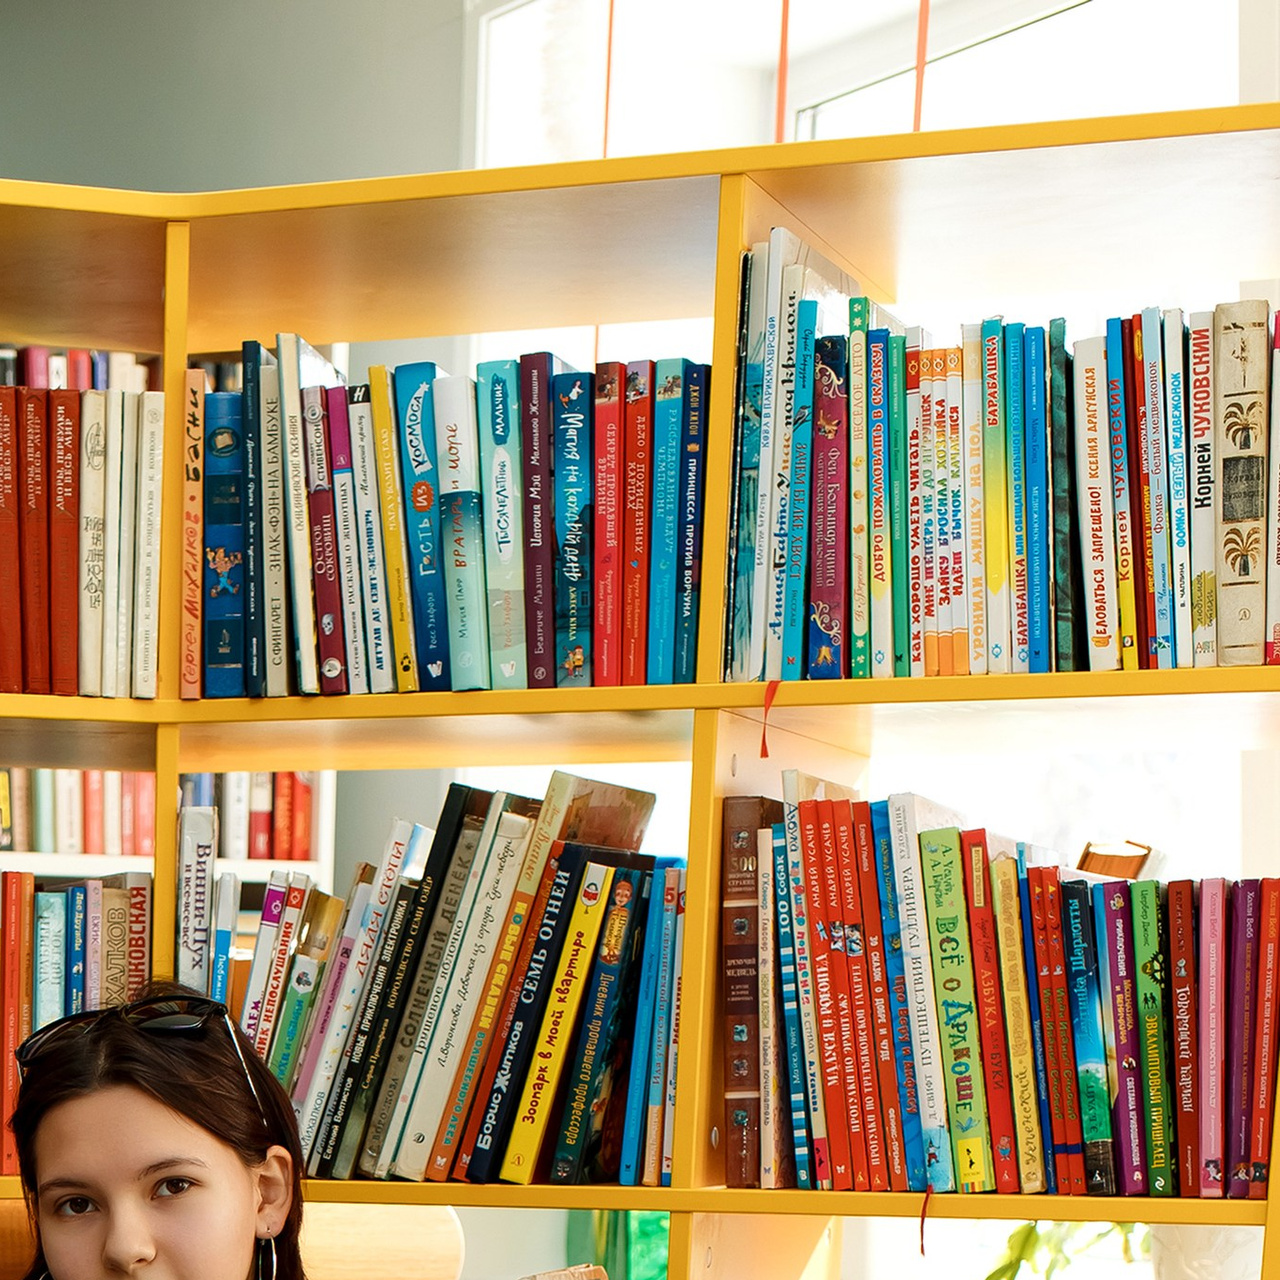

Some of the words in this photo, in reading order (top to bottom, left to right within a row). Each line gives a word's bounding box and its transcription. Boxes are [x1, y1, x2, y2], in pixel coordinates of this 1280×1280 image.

[529, 370, 539, 414] Женщины
[871, 343, 883, 405] СКАЗКУ!
[986, 337, 998, 426] БАРАБАШКА
[1084, 368, 1097, 432] ДРАГУНСКАЯ
[1190, 329, 1211, 438] ЧУКОВСКИЙ
[57, 406, 65, 463] ПЕРЕУЛКИ
[64, 418, 72, 446] МИР
[530, 418, 540, 465] Маленькой
[872, 410, 883, 418] В
[64, 451, 72, 483] ВЕСЬ
[313, 424, 326, 481] СТИВЕНСОН
[871, 425, 884, 529] ПОЖАЛОВАТЬ
[1086, 436, 1099, 479] КСЕНИЯ
[1195, 442, 1214, 508] Корней
[530, 475, 541, 498] Мэй
[687, 459, 697, 520] ПРИНЦЕССА
[321, 514, 335, 580] СОКРОВИЩ
[684, 525, 694, 565] ПРОТИВ
[910, 496, 920, 548] УМЕТЬ
[1088, 486, 1103, 561] ЗАПРЕЩЕНО!
[872, 533, 885, 582] ДОБРО
[682, 570, 692, 616] ВОРЧУНА
[910, 553, 920, 623] ХОРОШО
[1092, 569, 1111, 647] ЦЕЛОВАТЬСЯ
[911, 630, 921, 663] КАК
[805, 824, 817, 862] УСАЧЕВ
[808, 867, 820, 908] АНДРЕЙ
[902, 867, 920, 949] ГУЛЛИВЕРА
[521, 947, 548, 1004] СЕМЬ
[539, 871, 571, 940] ОГНЕЙ
[552, 931, 585, 1004] квартире
[543, 1010, 564, 1045] моей
[911, 956, 931, 1066] ПУТЕШЕСТВИЯ
[538, 1051, 552, 1059] в
[1145, 1015, 1162, 1103] ЭВКАЛИПТОВЫЙ
[521, 1064, 549, 1124] Зоопарк
[1151, 1108, 1165, 1168] ПРИШЕЛЕЦ
